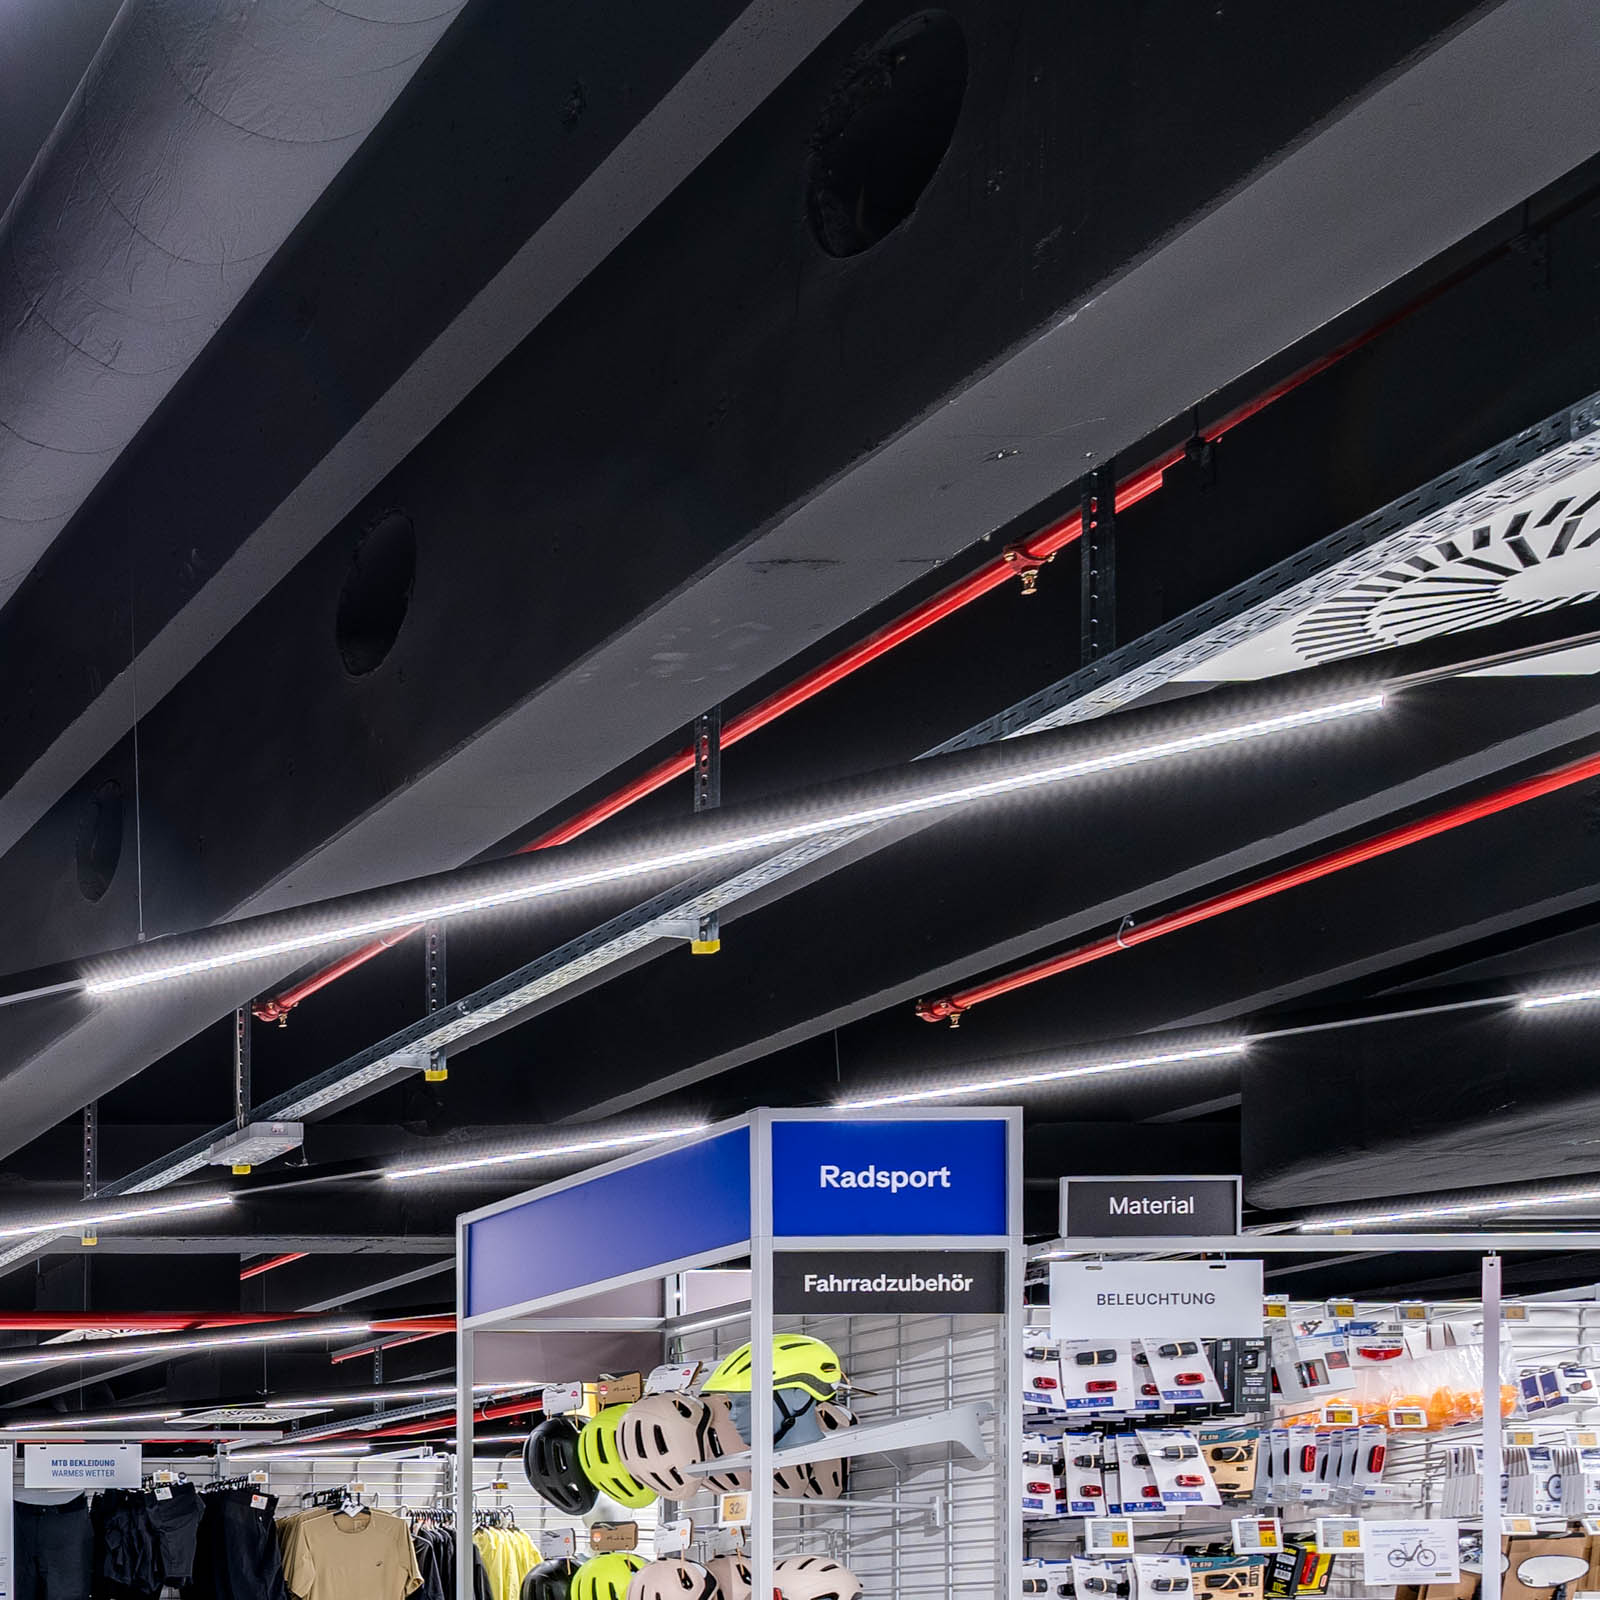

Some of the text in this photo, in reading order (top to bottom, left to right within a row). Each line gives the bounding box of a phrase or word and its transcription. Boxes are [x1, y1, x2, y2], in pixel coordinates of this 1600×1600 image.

[820, 1165, 950, 1193] Radsport
[1109, 1197, 1194, 1215] Material
[804, 1273, 973, 1294] Fahrradzubehör
[1097, 1292, 1215, 1306] BELEUCHTUNG
[52, 1459, 116, 1467] MTB BEKLEIDUNG
[52, 1469, 116, 1478] WARMES WETTER
